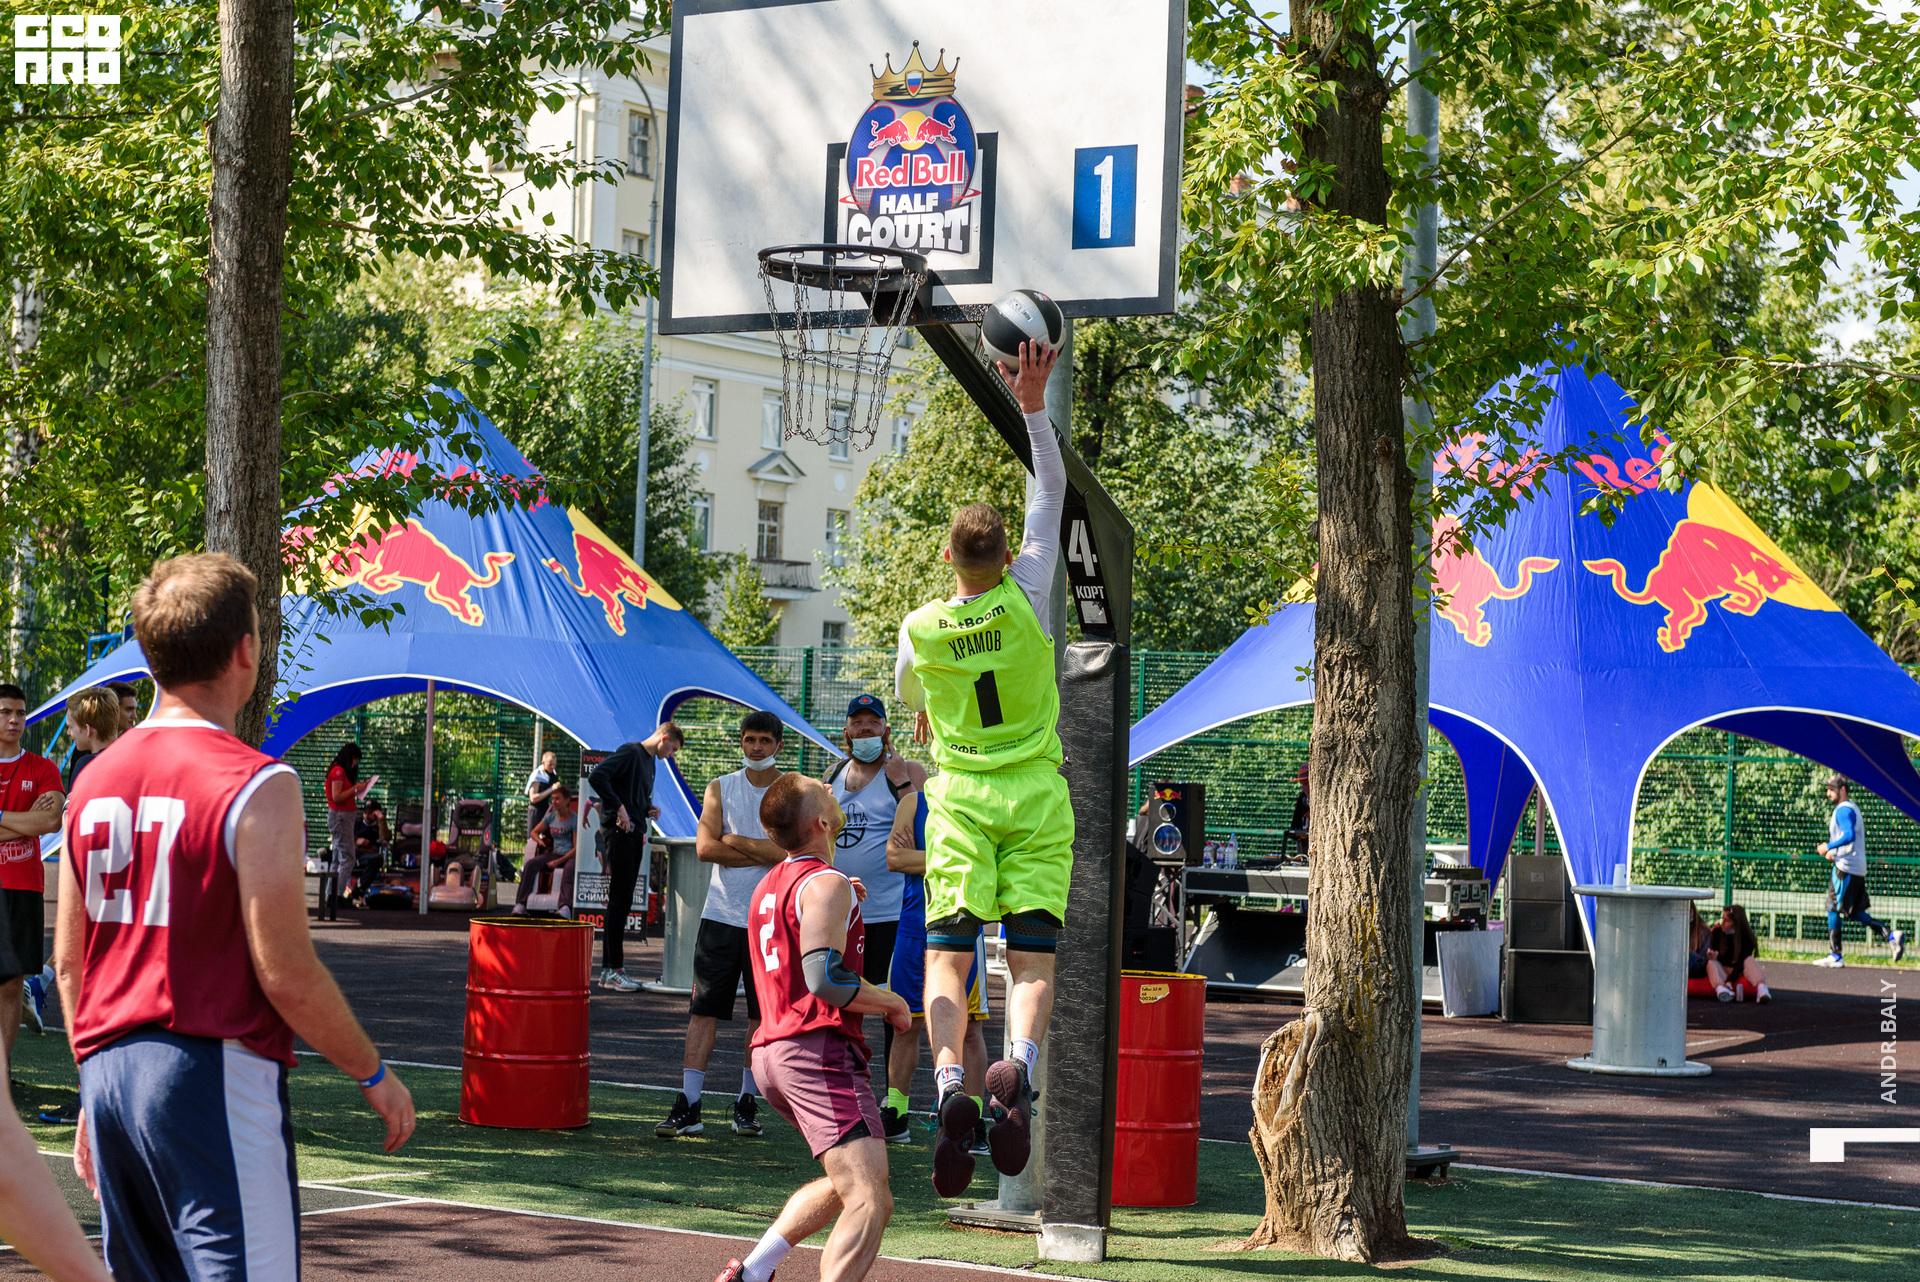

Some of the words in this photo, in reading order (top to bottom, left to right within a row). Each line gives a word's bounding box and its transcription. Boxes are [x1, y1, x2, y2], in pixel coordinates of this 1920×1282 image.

[857, 154, 910, 188] Red
[912, 151, 965, 186] Bull
[879, 192, 938, 215] HALF
[1094, 155, 1114, 239] 1
[848, 204, 969, 256] COURT
[1068, 520, 1098, 577] 4
[1075, 586, 1104, 599] КОРТ
[948, 630, 1002, 661] ХРАМОВ
[974, 670, 1004, 728] 1
[79, 796, 186, 927] 27
[759, 893, 780, 972] 2
